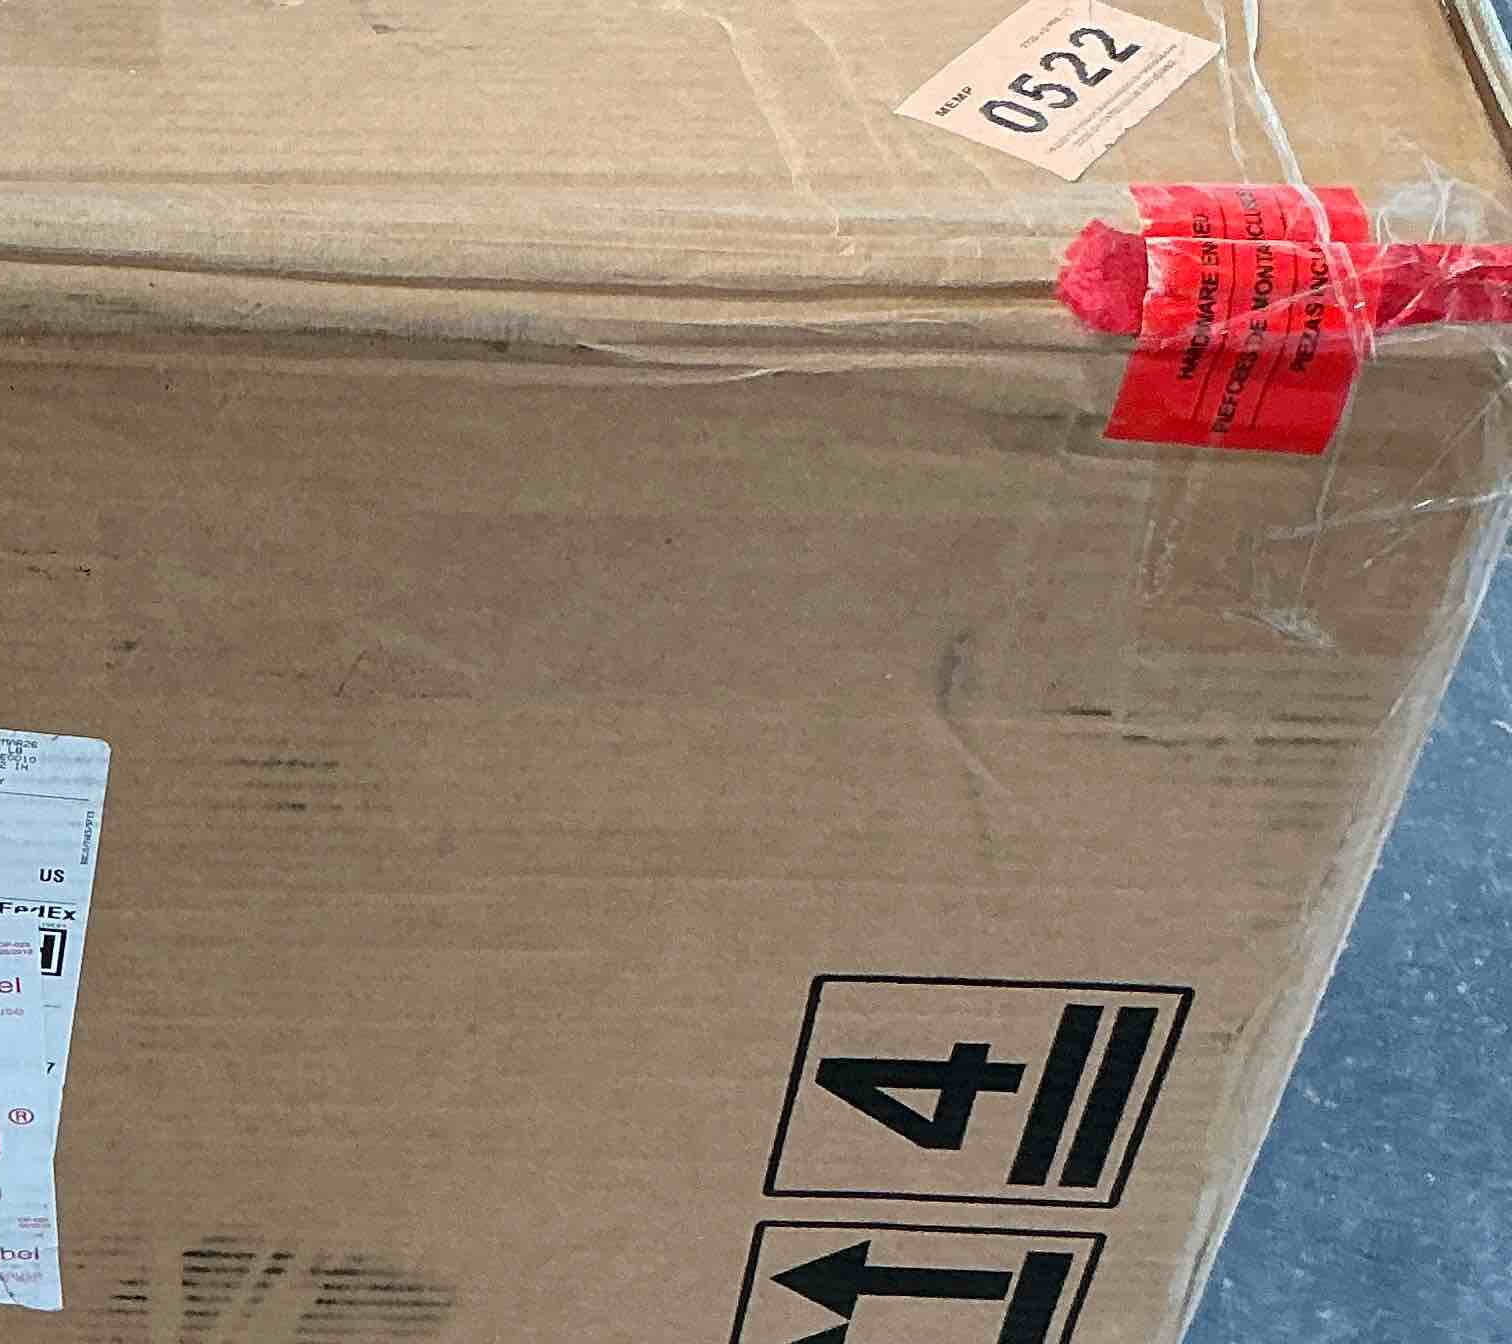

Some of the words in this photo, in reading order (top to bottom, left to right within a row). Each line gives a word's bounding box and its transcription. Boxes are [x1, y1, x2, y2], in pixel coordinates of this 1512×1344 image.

[979, 27, 1143, 133] 0522
[934, 86, 973, 117] MEMP
[40, 868, 65, 883] US
